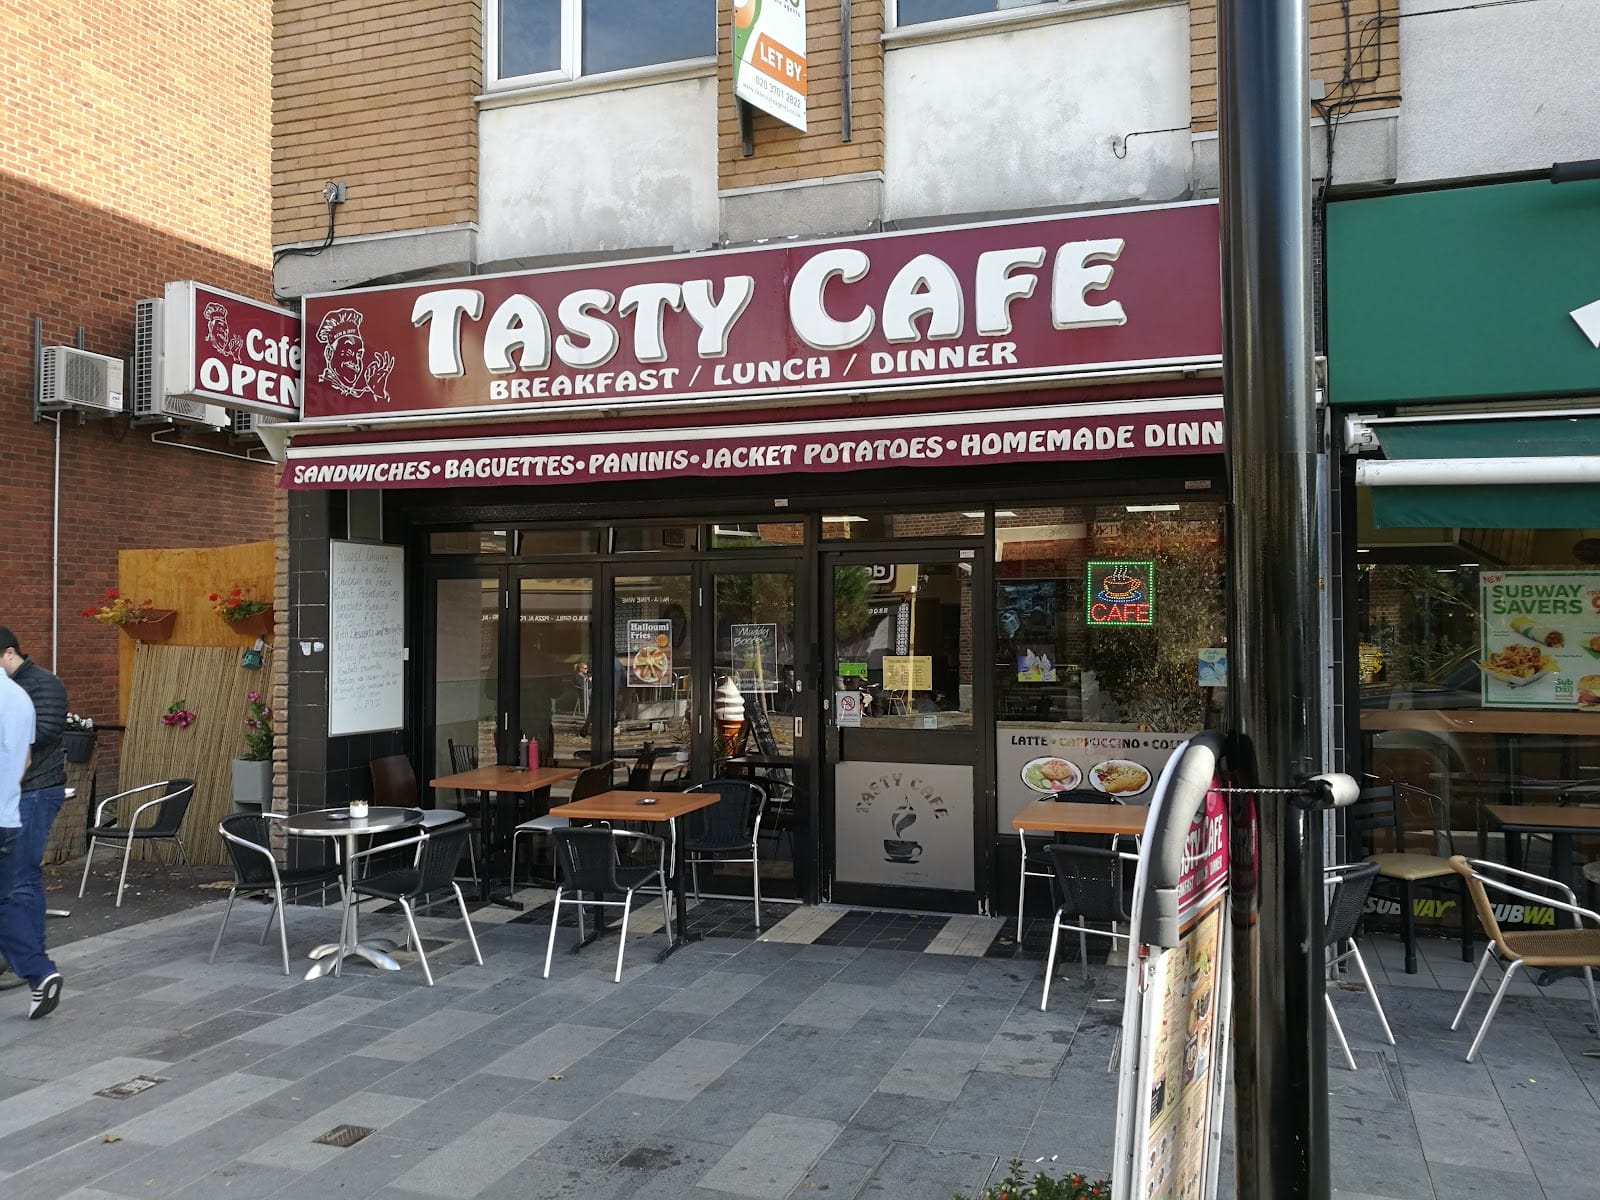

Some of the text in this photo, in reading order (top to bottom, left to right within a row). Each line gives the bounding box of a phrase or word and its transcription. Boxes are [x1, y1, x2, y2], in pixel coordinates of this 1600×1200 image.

[760, 41, 802, 82] LET BY
[755, 75, 768, 90] 020
[411, 238, 1127, 379] TASTY CAFE
[246, 328, 301, 371] Café
[489, 367, 680, 401] BREAKFAST
[714, 355, 831, 387] LUNCH
[870, 341, 1018, 375] DINNER
[200, 357, 301, 408] OPEN
[293, 460, 432, 484] SANDWICHES
[444, 455, 576, 479] BAGUETTES
[588, 449, 689, 474] PANINIS
[702, 444, 798, 469] JACKET
[803, 435, 944, 465] POTATOES
[961, 425, 1135, 457] HOMEMADE
[1483, 576, 1502, 584] NEW
[1492, 584, 1584, 598] SUBWAY
[1090, 603, 1150, 623] CAFE
[1492, 599, 1583, 615] SAVERS
[630, 623, 669, 631] Halloumi
[630, 631, 651, 639] Fries
[1011, 735, 1048, 747] LATTE
